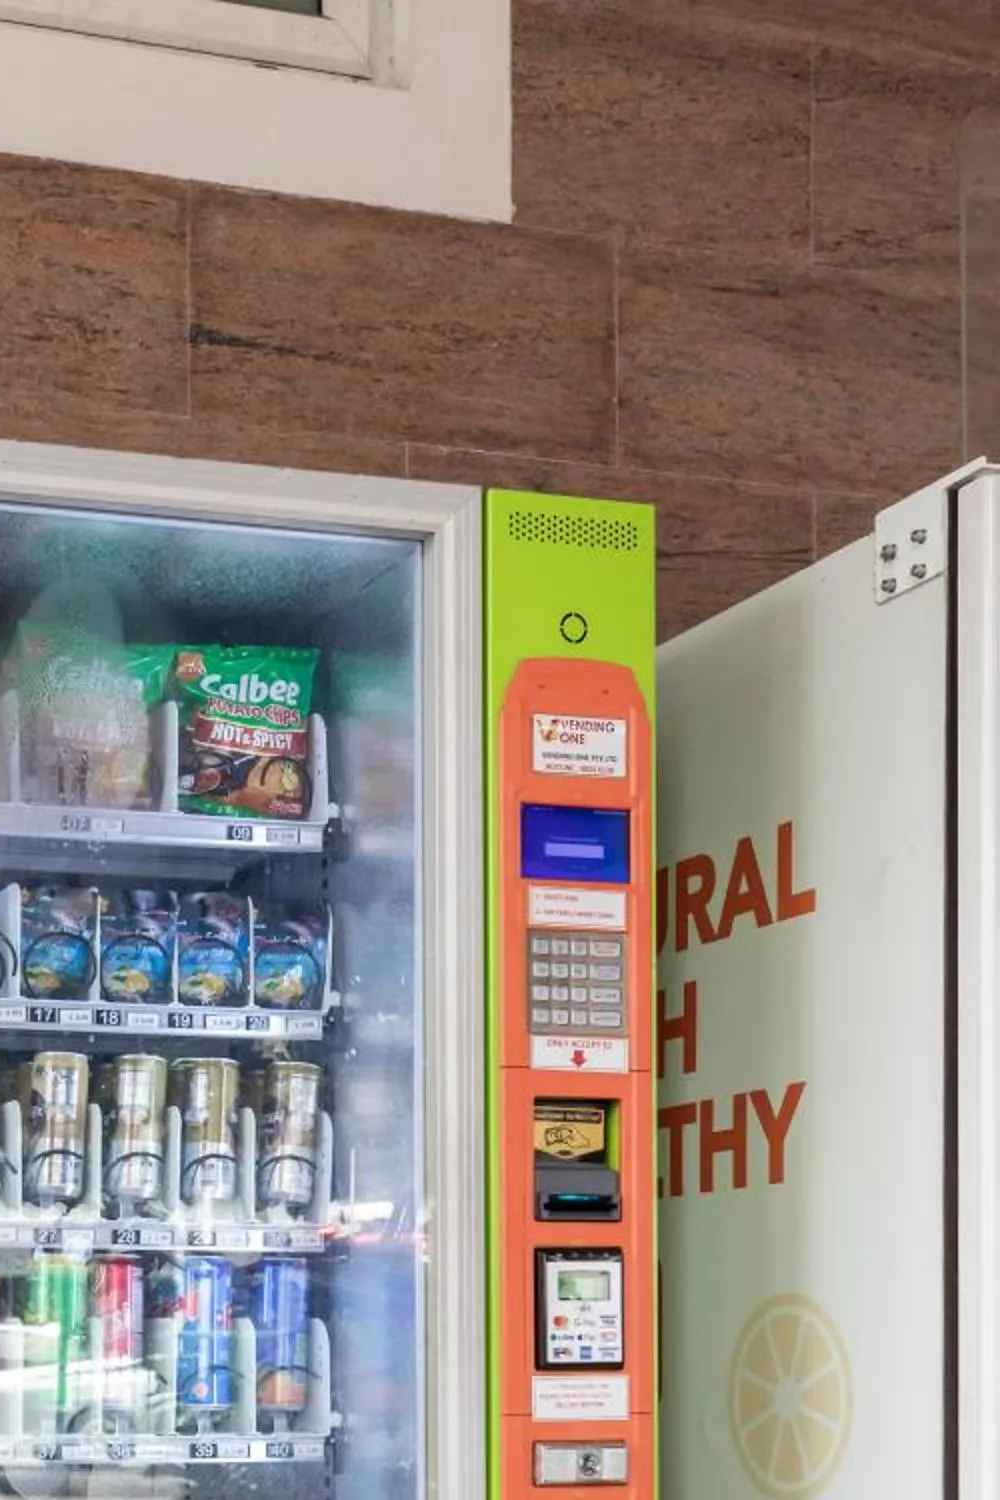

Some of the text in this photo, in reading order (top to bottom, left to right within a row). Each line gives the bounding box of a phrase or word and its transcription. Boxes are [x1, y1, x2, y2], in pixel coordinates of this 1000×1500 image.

[200, 673, 300, 706] Calbee
[265, 704, 300, 726] CHIPS
[561, 719, 615, 733] VENDING
[559, 732, 585, 745] ONE
[231, 826, 250, 840] 09
[34, 1008, 54, 1023] 17
[100, 1010, 119, 1025] 18
[172, 1012, 191, 1028] 19
[657, 1081, 806, 1198] THY
[38, 1228, 57, 1243] 27
[118, 1229, 137, 1244] 28
[194, 1444, 214, 1458] 39
